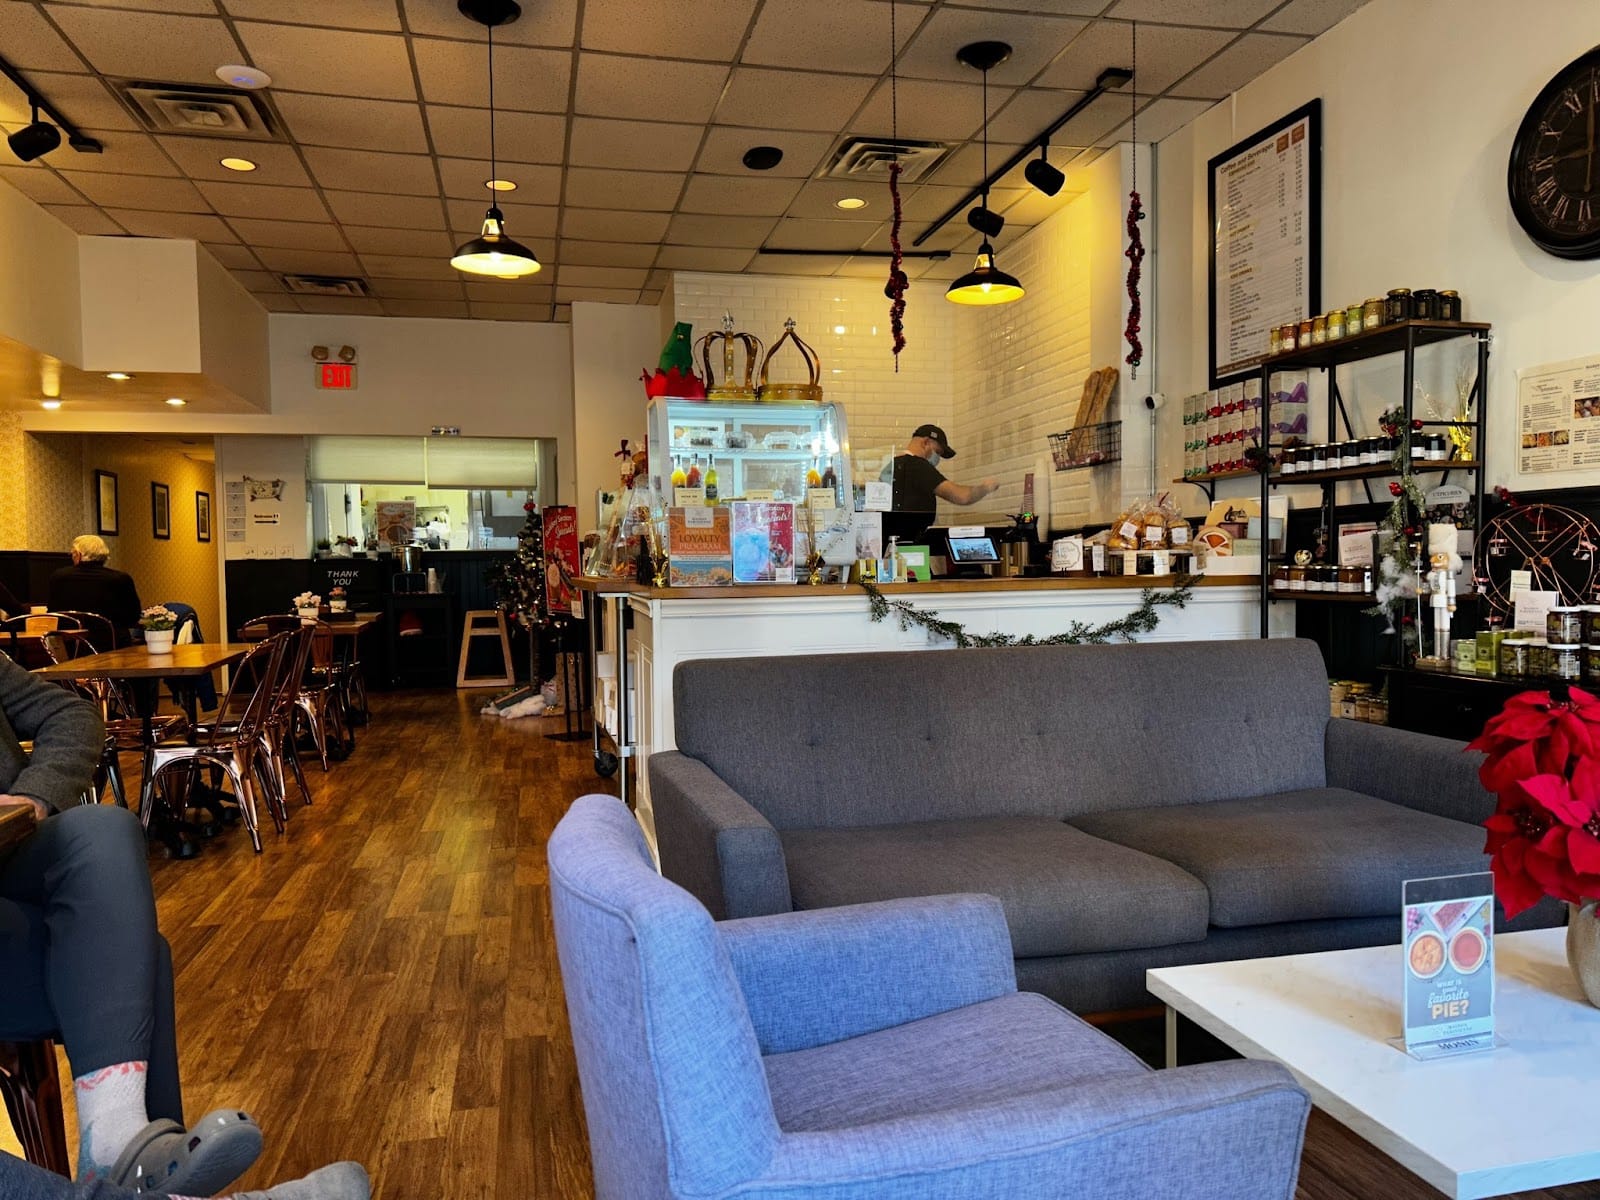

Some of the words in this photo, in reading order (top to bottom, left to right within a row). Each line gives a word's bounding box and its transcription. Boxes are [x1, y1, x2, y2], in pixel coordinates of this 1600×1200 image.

[322, 364, 352, 388] EXIT
[679, 534, 721, 543] LOYALTY
[679, 543, 721, 551] PROGRAM
[327, 570, 359, 578] THANK
[332, 578, 352, 586] YOU
[1427, 988, 1470, 1009] favorite
[1431, 999, 1470, 1020] PIE?
